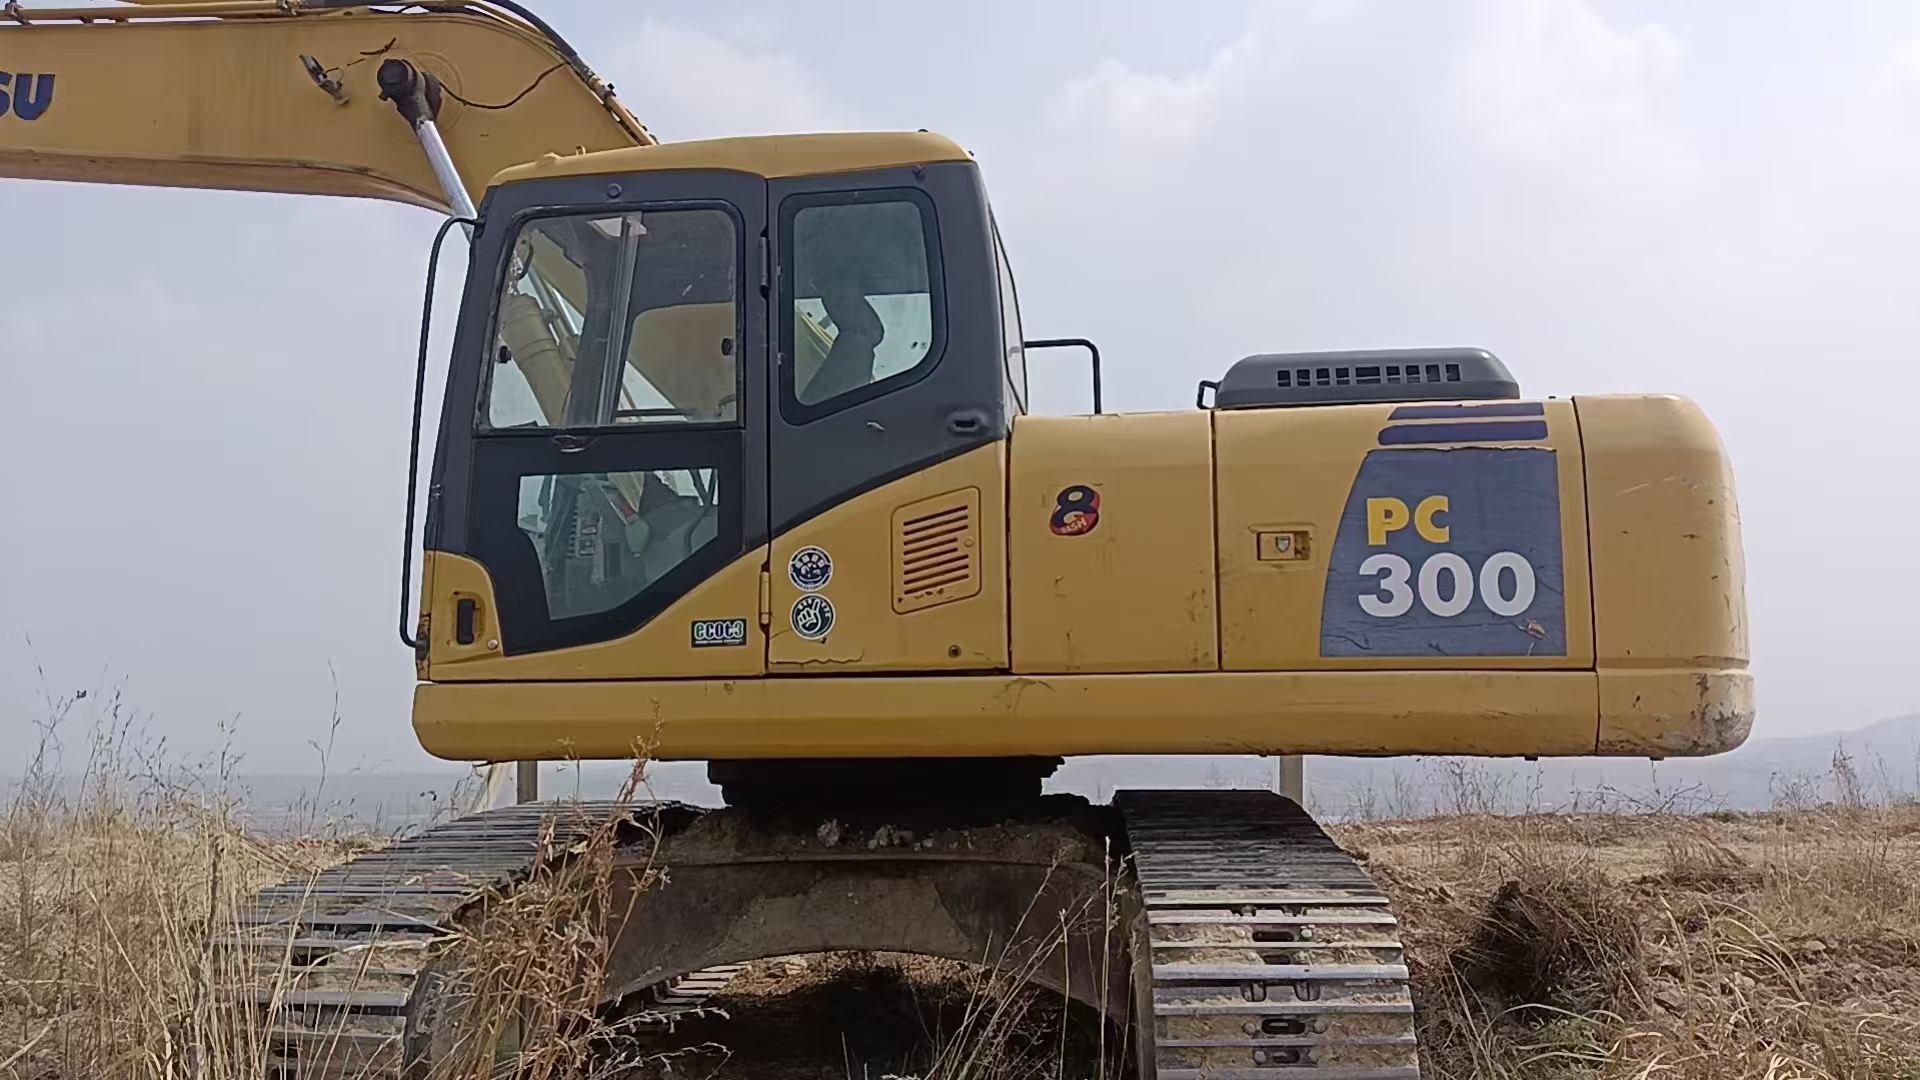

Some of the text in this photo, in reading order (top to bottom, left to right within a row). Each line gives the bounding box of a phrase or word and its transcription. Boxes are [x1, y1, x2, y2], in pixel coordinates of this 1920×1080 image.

[1366, 495, 1450, 546] PC
[1357, 551, 1536, 618] 300
[694, 621, 744, 640] ecot3
